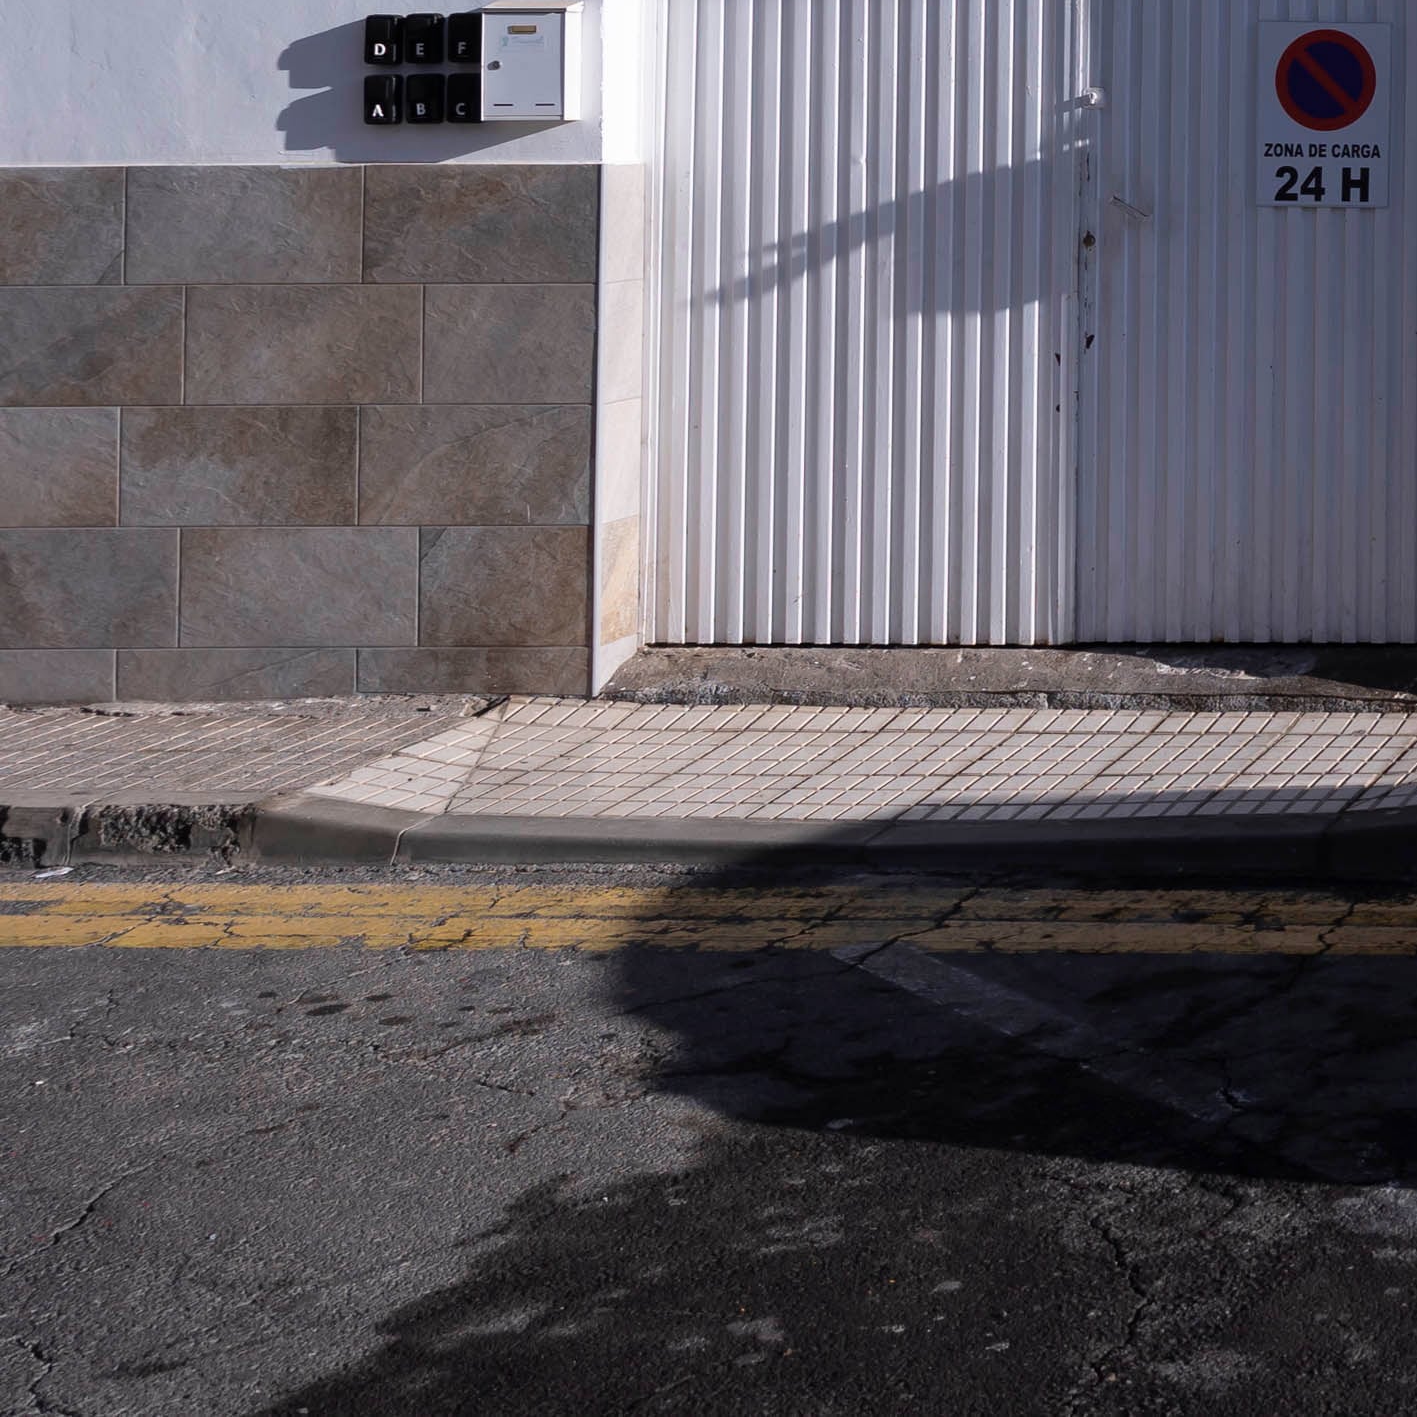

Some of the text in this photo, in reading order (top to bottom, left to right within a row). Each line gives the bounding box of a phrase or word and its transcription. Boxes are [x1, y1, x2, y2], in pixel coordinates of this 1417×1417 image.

[374, 43, 386, 56] D
[415, 43, 425, 56] E
[457, 42, 467, 55] F
[372, 104, 384, 117] A
[416, 103, 426, 116] B
[455, 102, 466, 116] C
[1263, 143, 1381, 158] ZONA DE CARGA
[1274, 165, 1370, 202] 24 H
